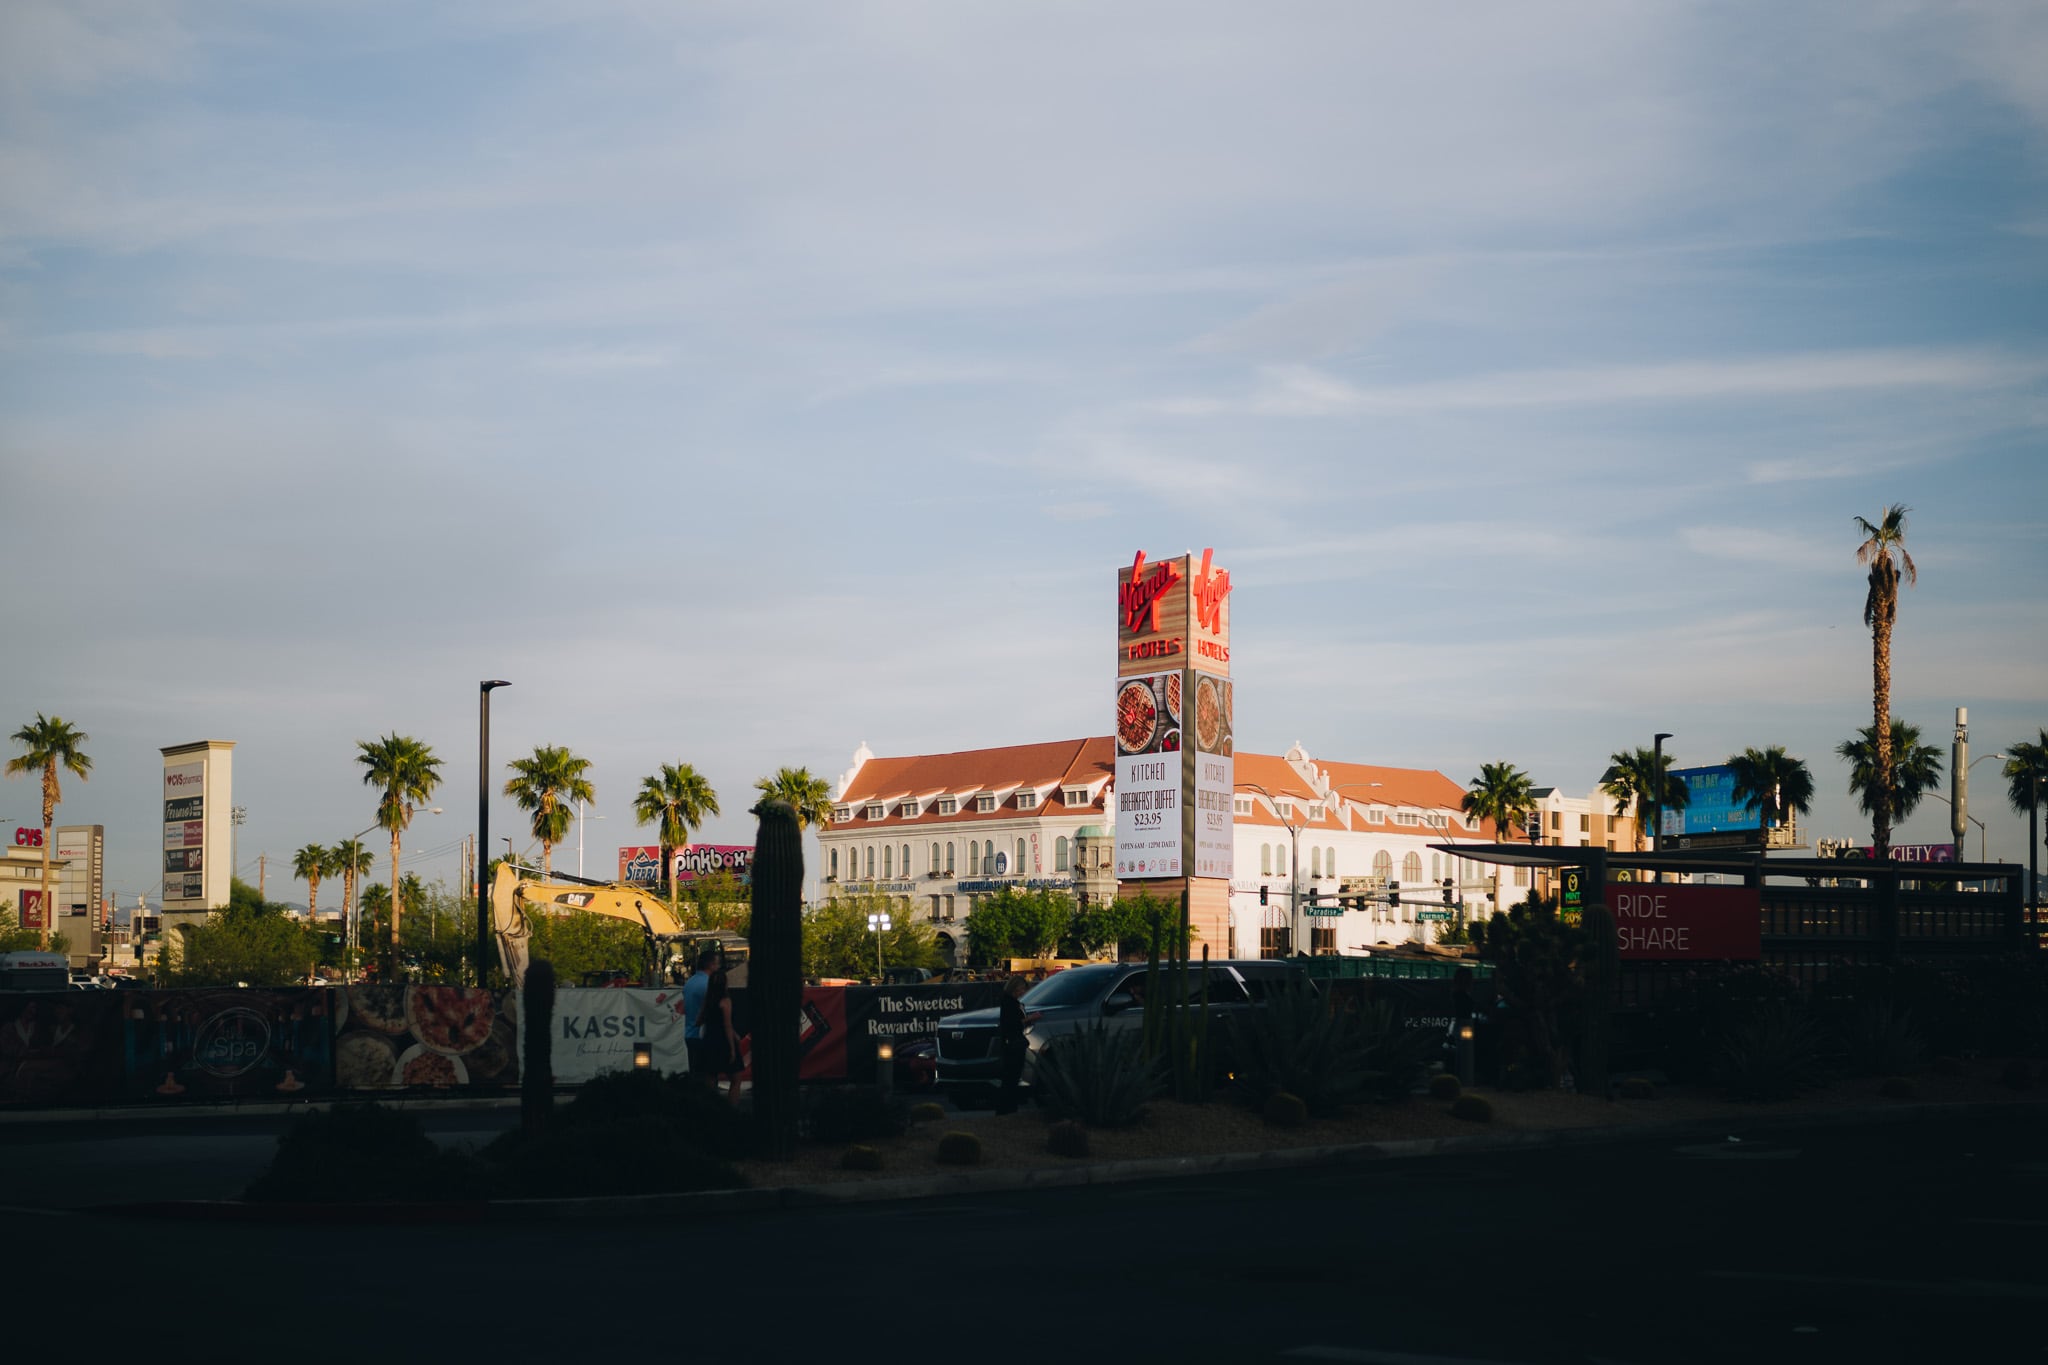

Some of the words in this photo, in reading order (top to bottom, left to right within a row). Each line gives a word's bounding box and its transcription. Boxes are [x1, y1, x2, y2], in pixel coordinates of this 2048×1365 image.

[1128, 638, 1183, 661] HOTELS
[1198, 639, 1229, 662] HOTELS
[1131, 763, 1165, 783] KITCHEN
[1120, 790, 1153, 812] BREAKFAST
[1154, 789, 1176, 810] BUFFET
[1134, 812, 1162, 826] $23.95
[15, 827, 43, 846] CVS
[1120, 842, 1134, 850] OPEN
[93, 836, 102, 881] PARADISE
[676, 848, 746, 876] pinkbox
[1030, 833, 1042, 873] OPEN
[567, 893, 586, 906] CAT
[1617, 895, 1667, 918] RIDE
[1309, 907, 1338, 916] Paradise
[1617, 927, 1689, 950] SHARE
[878, 996, 903, 1013] The
[904, 995, 964, 1012] Sweetest
[563, 1015, 646, 1039] KASSI
[867, 1017, 924, 1035] Rewards
[926, 1017, 937, 1032] in
[214, 1036, 257, 1061] Spa
